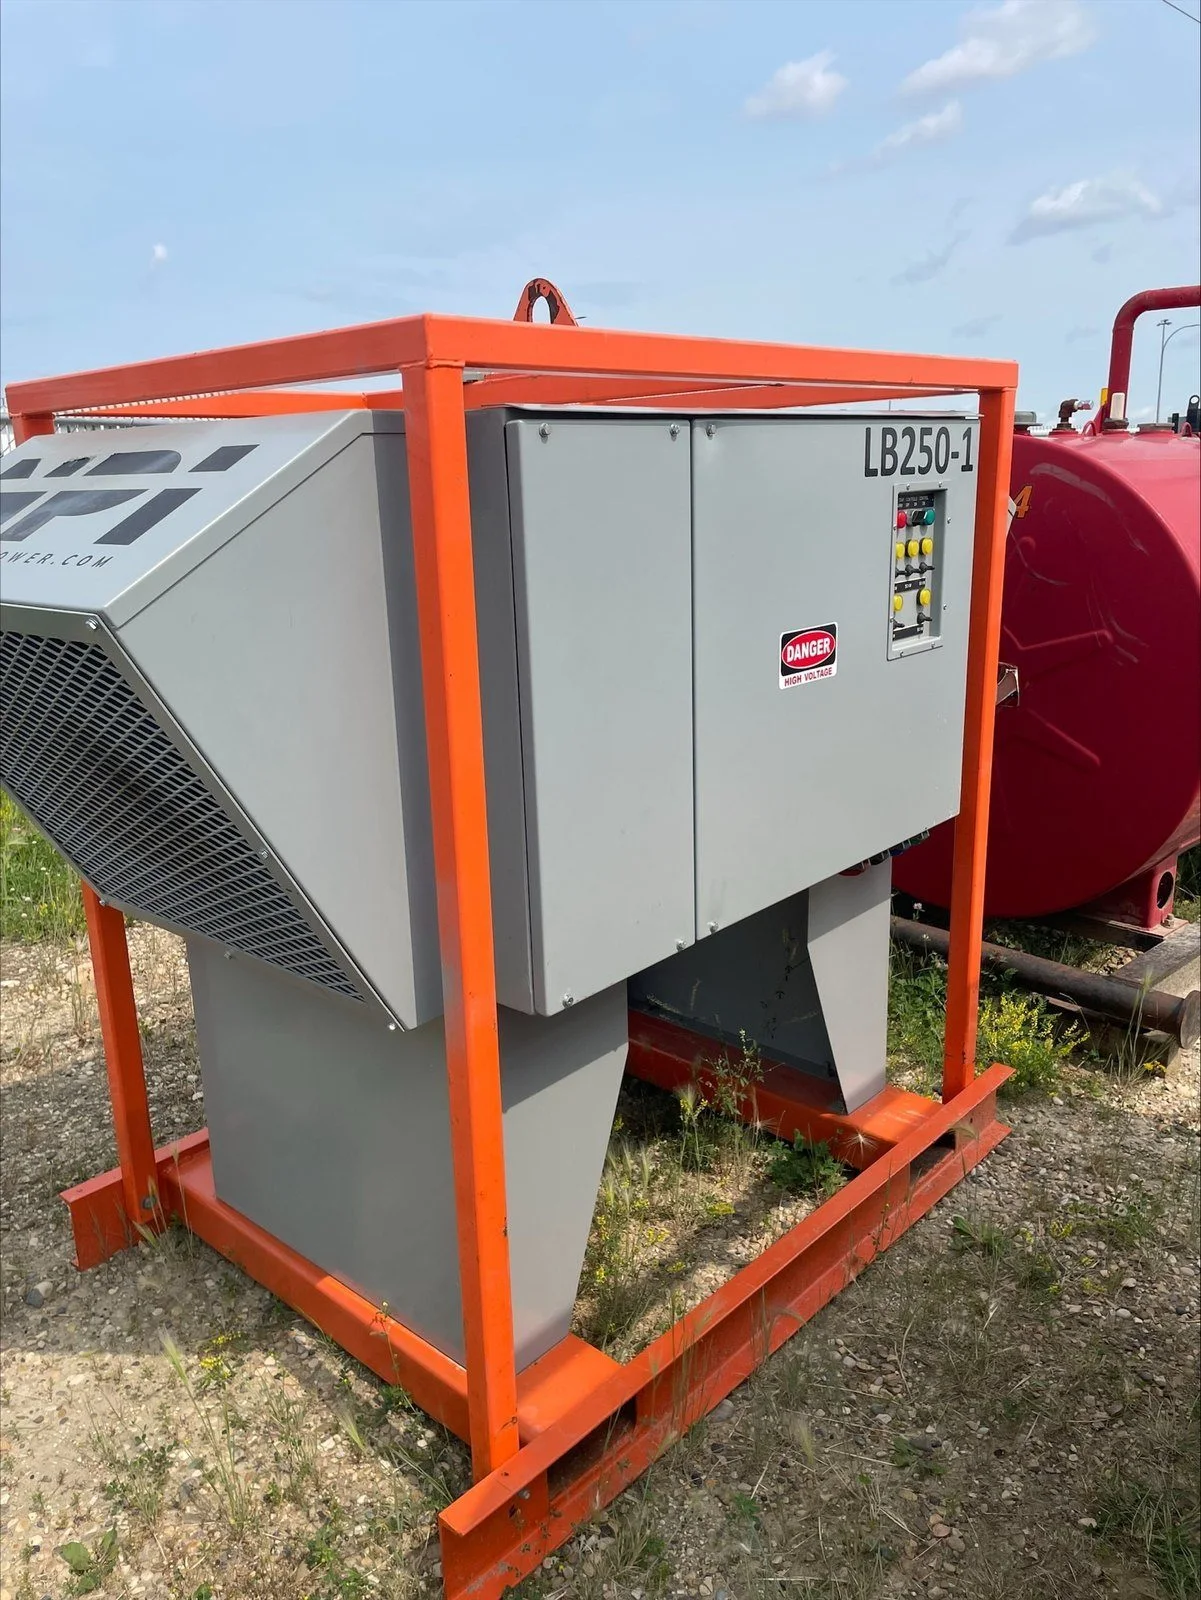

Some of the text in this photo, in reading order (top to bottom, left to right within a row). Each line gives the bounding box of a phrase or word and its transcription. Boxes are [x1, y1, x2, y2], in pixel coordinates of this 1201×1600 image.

[864, 426, 974, 477] LB250-1
[1014, 485, 1033, 518] 4
[786, 637, 831, 663] DANGER
[784, 666, 833, 687] HIGH VOLTAGE
